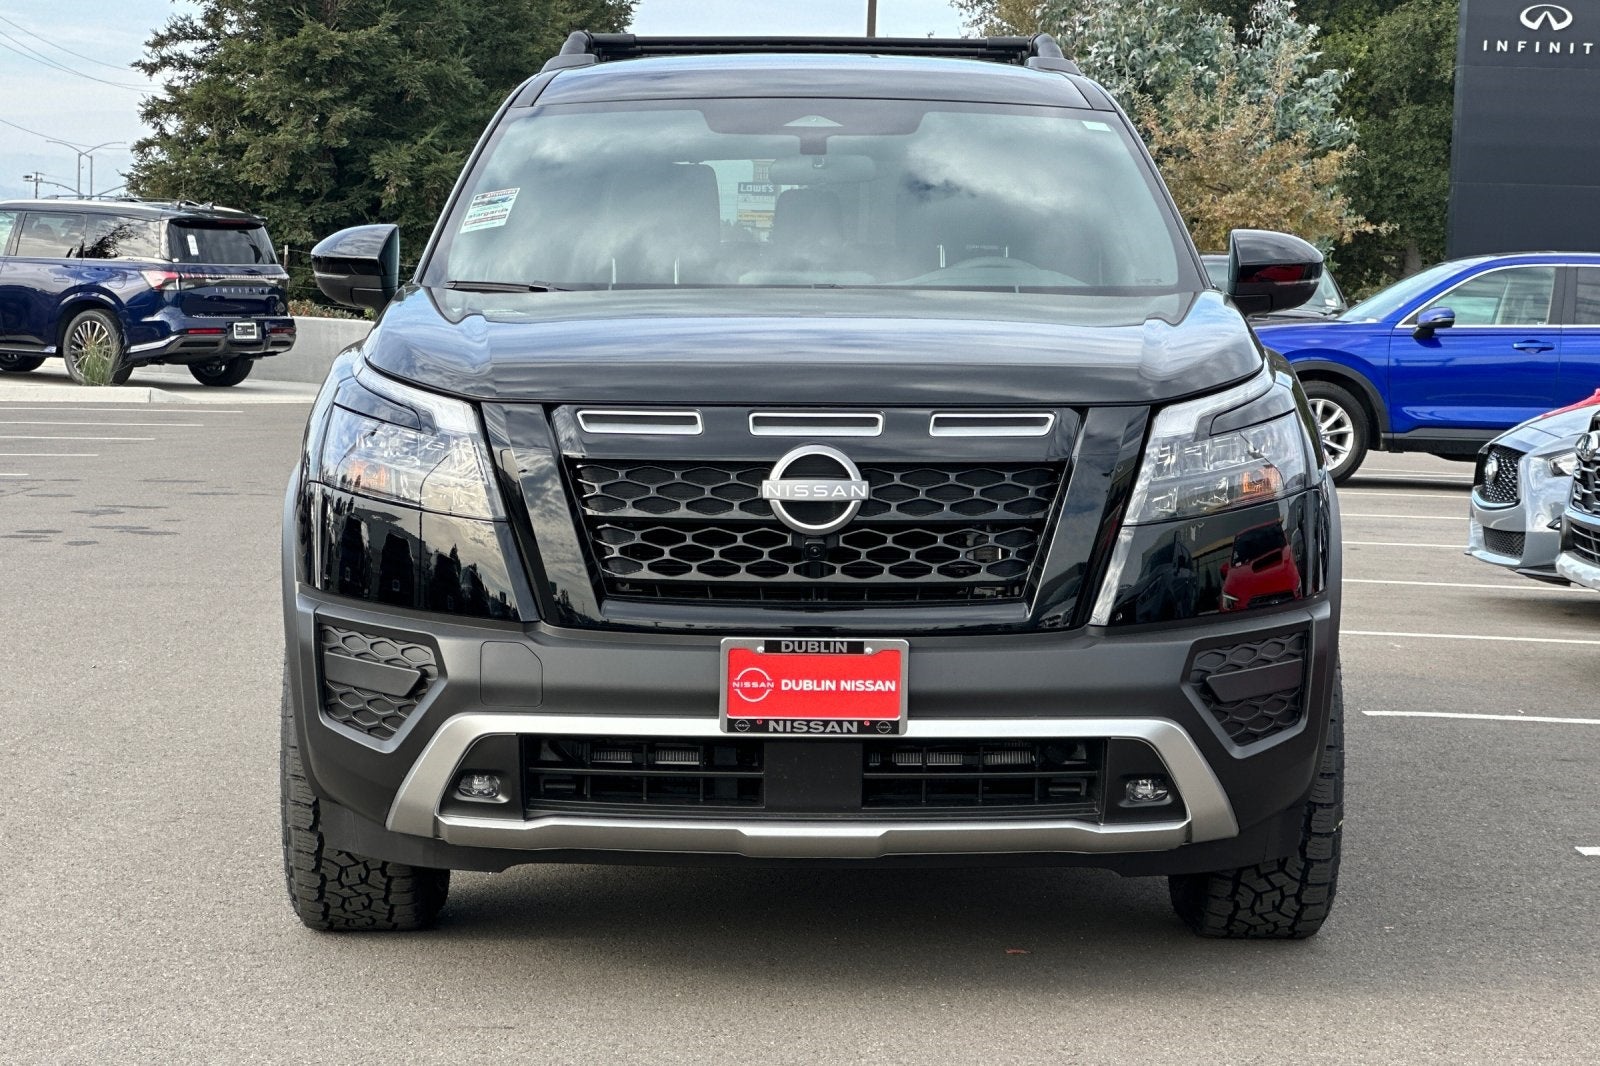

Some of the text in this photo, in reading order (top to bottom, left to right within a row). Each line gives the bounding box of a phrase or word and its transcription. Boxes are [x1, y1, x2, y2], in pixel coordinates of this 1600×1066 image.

[740, 183, 774, 193] LOWE'S
[766, 484, 866, 497] NISSAN
[781, 641, 848, 653] DUBLIN
[781, 680, 896, 692] DUBLIN NISSAN
[768, 720, 858, 733] NISSAN
